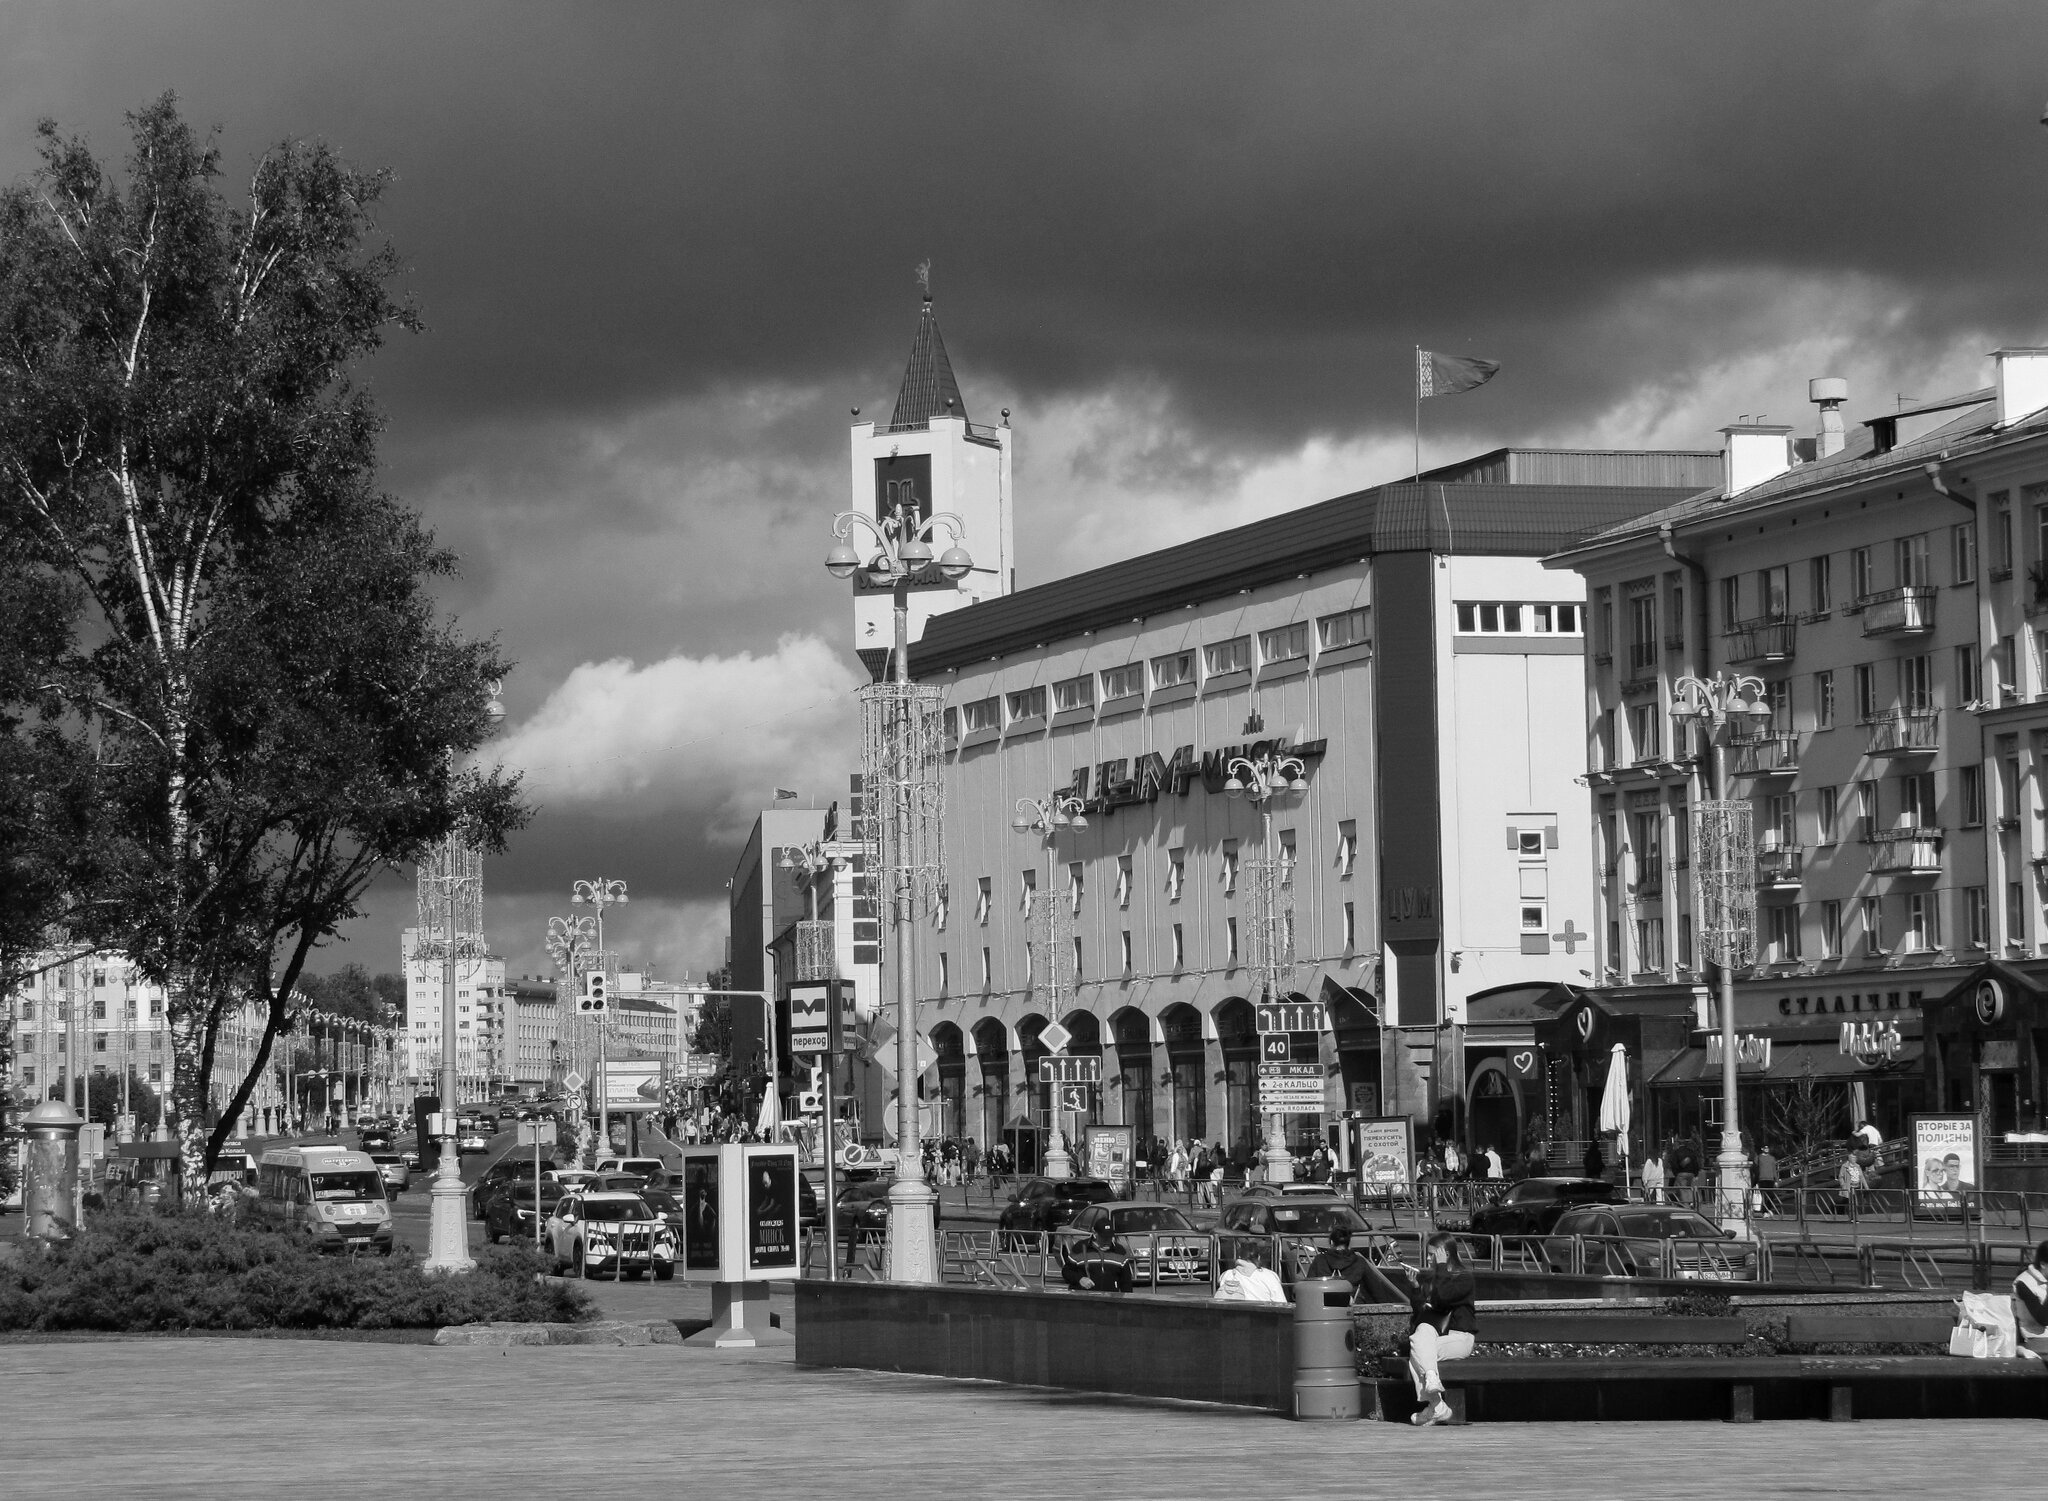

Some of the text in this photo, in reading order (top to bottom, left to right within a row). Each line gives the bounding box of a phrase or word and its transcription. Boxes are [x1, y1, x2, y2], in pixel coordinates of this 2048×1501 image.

[793, 1036, 826, 1048] переход
[1267, 1041, 1286, 1054] 40
[1289, 1066, 1315, 1074] МКАД
[1284, 1080, 1318, 1089] КАЛЬЦО
[1917, 1122, 1971, 1131] ВТОРЫЕ ЗА
[1917, 1133, 1972, 1143] ПОЛЦЕНЫ
